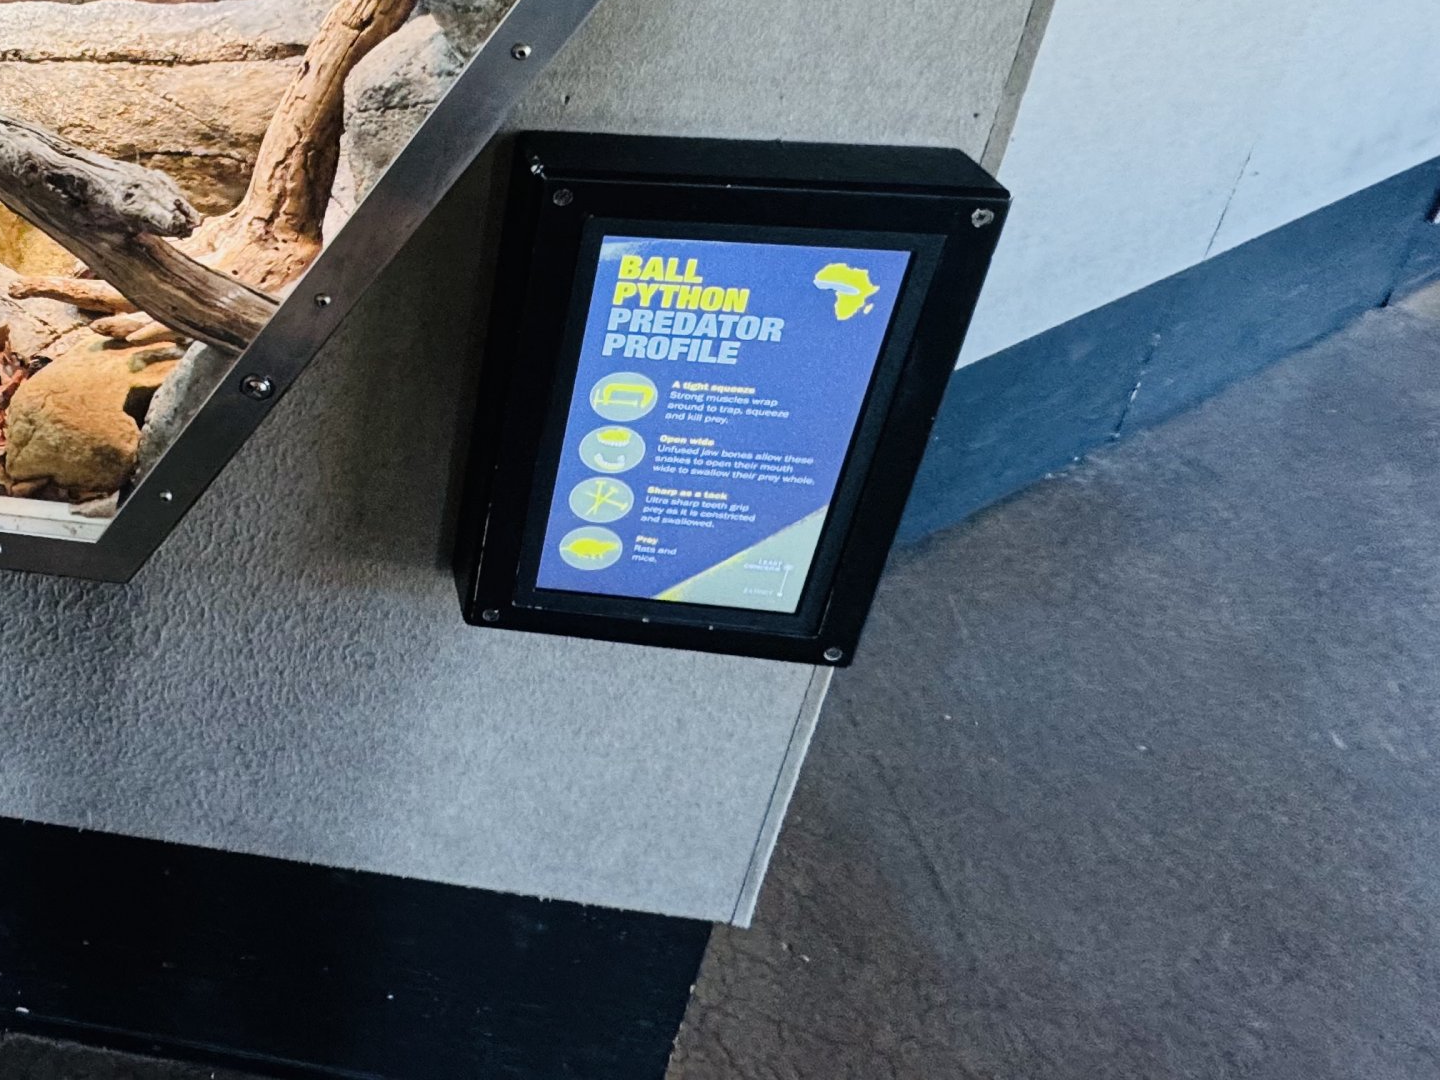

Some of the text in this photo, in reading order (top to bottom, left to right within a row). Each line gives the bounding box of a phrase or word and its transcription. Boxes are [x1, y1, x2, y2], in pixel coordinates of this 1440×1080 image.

[618, 254, 702, 283] BALL
[613, 281, 750, 312] PYTHON
[607, 308, 785, 342] PREDATOR
[602, 333, 740, 364] PROFILE
[671, 380, 756, 394] A tight squeeze
[669, 390, 779, 407] Strong muscles wrap
[664, 412, 729, 424] and kill prey.
[667, 402, 705, 411] around
[706, 404, 718, 412] to
[745, 408, 790, 418] squeeze
[659, 434, 715, 446] Open wide
[657, 444, 814, 464] Unfused jaw bones allow these
[654, 455, 794, 472] snakes to open their mouth
[652, 465, 677, 473] wide
[690, 468, 731, 477] swallow
[732, 471, 756, 479] their
[757, 474, 781, 482] prey
[647, 486, 678, 496] Sharp
[645, 495, 750, 512] Ultra sharp teeth grip
[642, 506, 665, 514] prey
[700, 511, 756, 521] constricted
[661, 517, 715, 527] swallowed.
[635, 535, 659, 544] Prey
[633, 544, 656, 553] Rats
[631, 554, 657, 562] mice.
